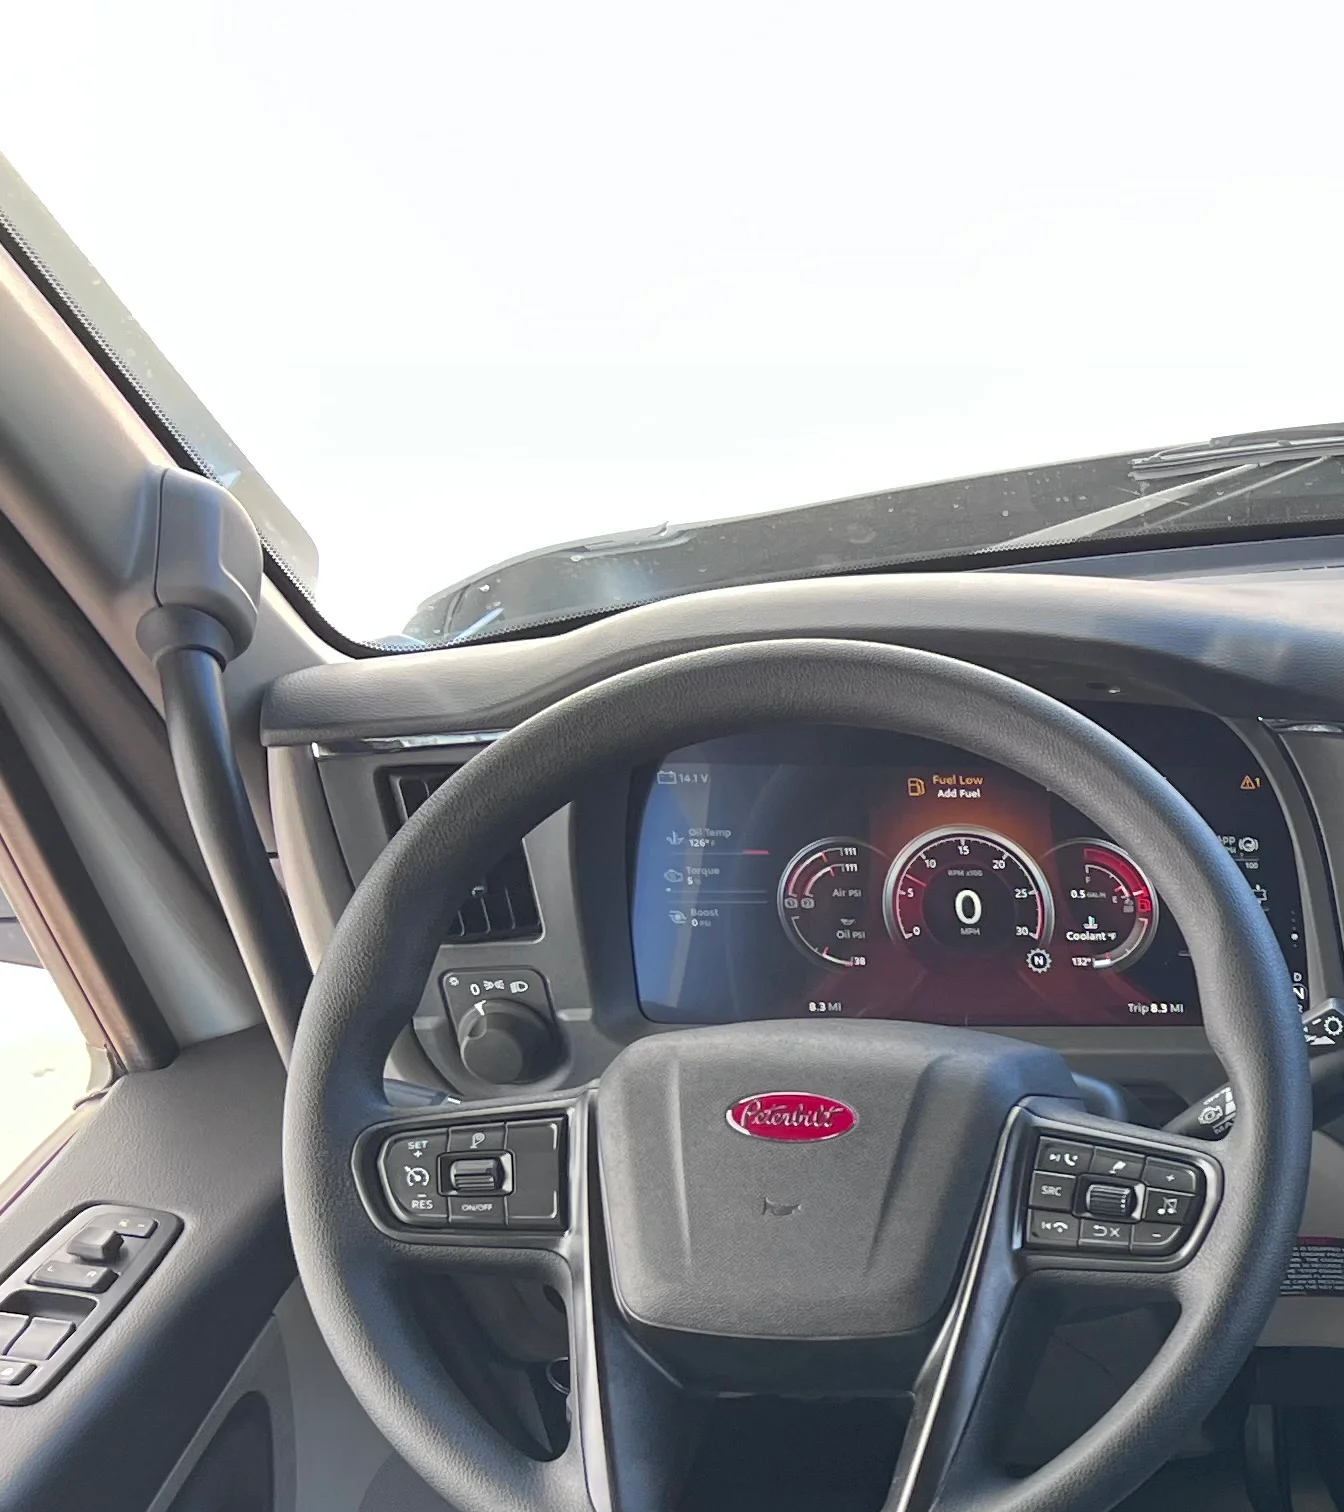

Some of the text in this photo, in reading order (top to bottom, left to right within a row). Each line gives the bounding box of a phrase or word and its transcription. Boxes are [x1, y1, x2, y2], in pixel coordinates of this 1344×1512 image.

[679, 773, 709, 784] 14.1 V
[932, 774, 984, 786] Fuel Low
[1254, 778, 1261, 787] 1
[937, 789, 981, 799] Add Fuel
[704, 828, 732, 840] Temp
[958, 845, 970, 856] 15
[925, 859, 937, 869] 10
[992, 860, 1006, 870] 20
[686, 866, 720, 878] Torque
[832, 888, 862, 898] Air PSI
[907, 888, 915, 899] 5
[1014, 888, 1028, 899] 25
[1070, 890, 1086, 899] 0.5
[690, 908, 719, 917] Boost
[954, 889, 982, 926] 0
[692, 918, 699, 927] 0
[836, 930, 866, 940] Oil PSI
[912, 926, 921, 936] 0
[960, 926, 981, 936] MPH
[1015, 926, 1029, 936] 30
[1065, 931, 1107, 942] Coolant
[1034, 955, 1045, 966] N
[1293, 972, 1303, 982] D
[808, 1002, 826, 1013] 8.3
[1127, 1003, 1149, 1015] Trip
[1150, 1003, 1168, 1014] 8.3
[741, 1099, 845, 1128] Peterbilt
[408, 1140, 428, 1150] SET
[1041, 1185, 1062, 1197] SRC
[411, 1199, 433, 1210] RES
[461, 1203, 493, 1212] ON/OFF
